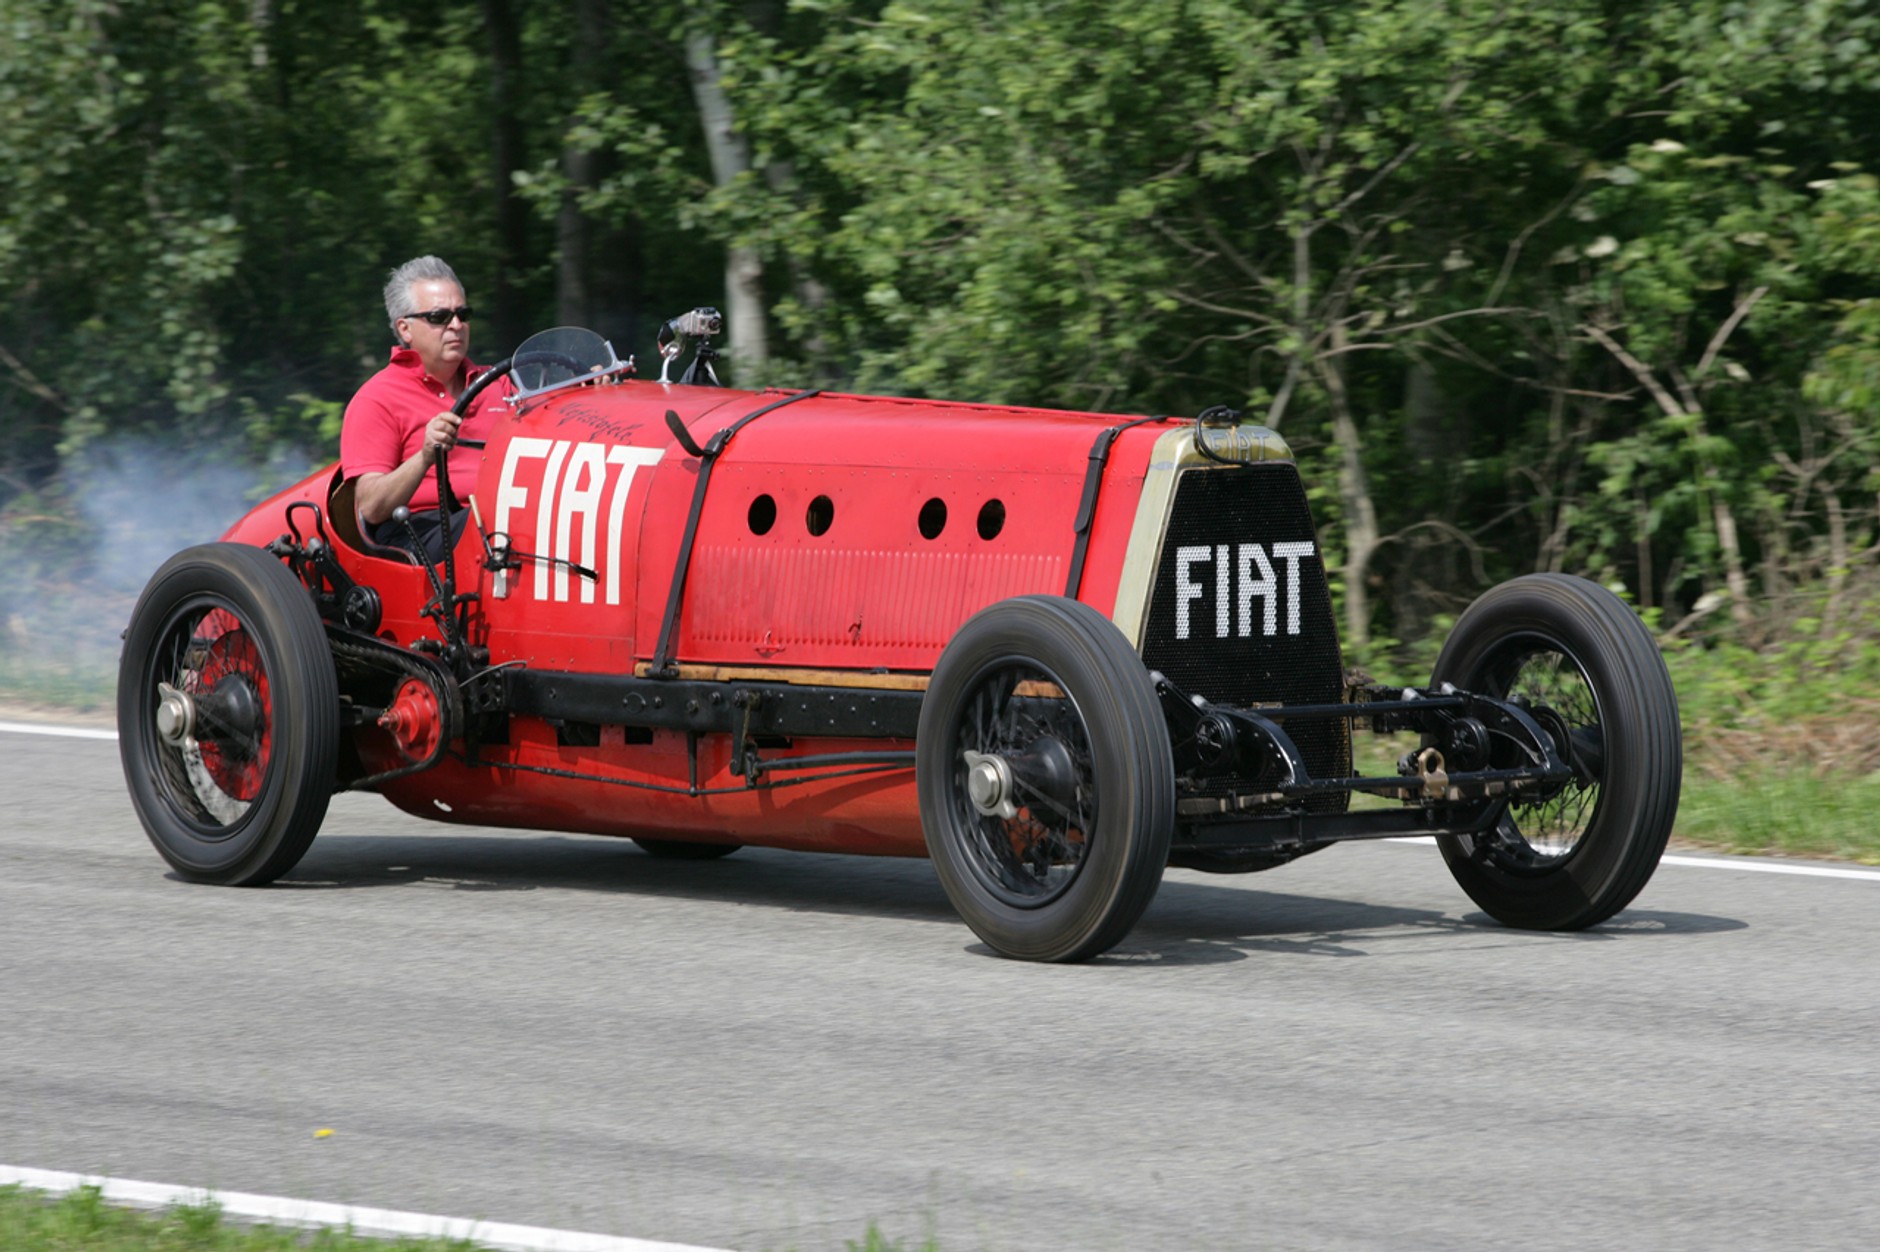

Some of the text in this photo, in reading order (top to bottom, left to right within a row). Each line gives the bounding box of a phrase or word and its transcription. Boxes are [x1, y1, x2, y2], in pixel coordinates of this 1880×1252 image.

[1209, 433, 1269, 461] FIAT
[493, 437, 665, 604] FIAT
[1176, 542, 1314, 639] FIAT
